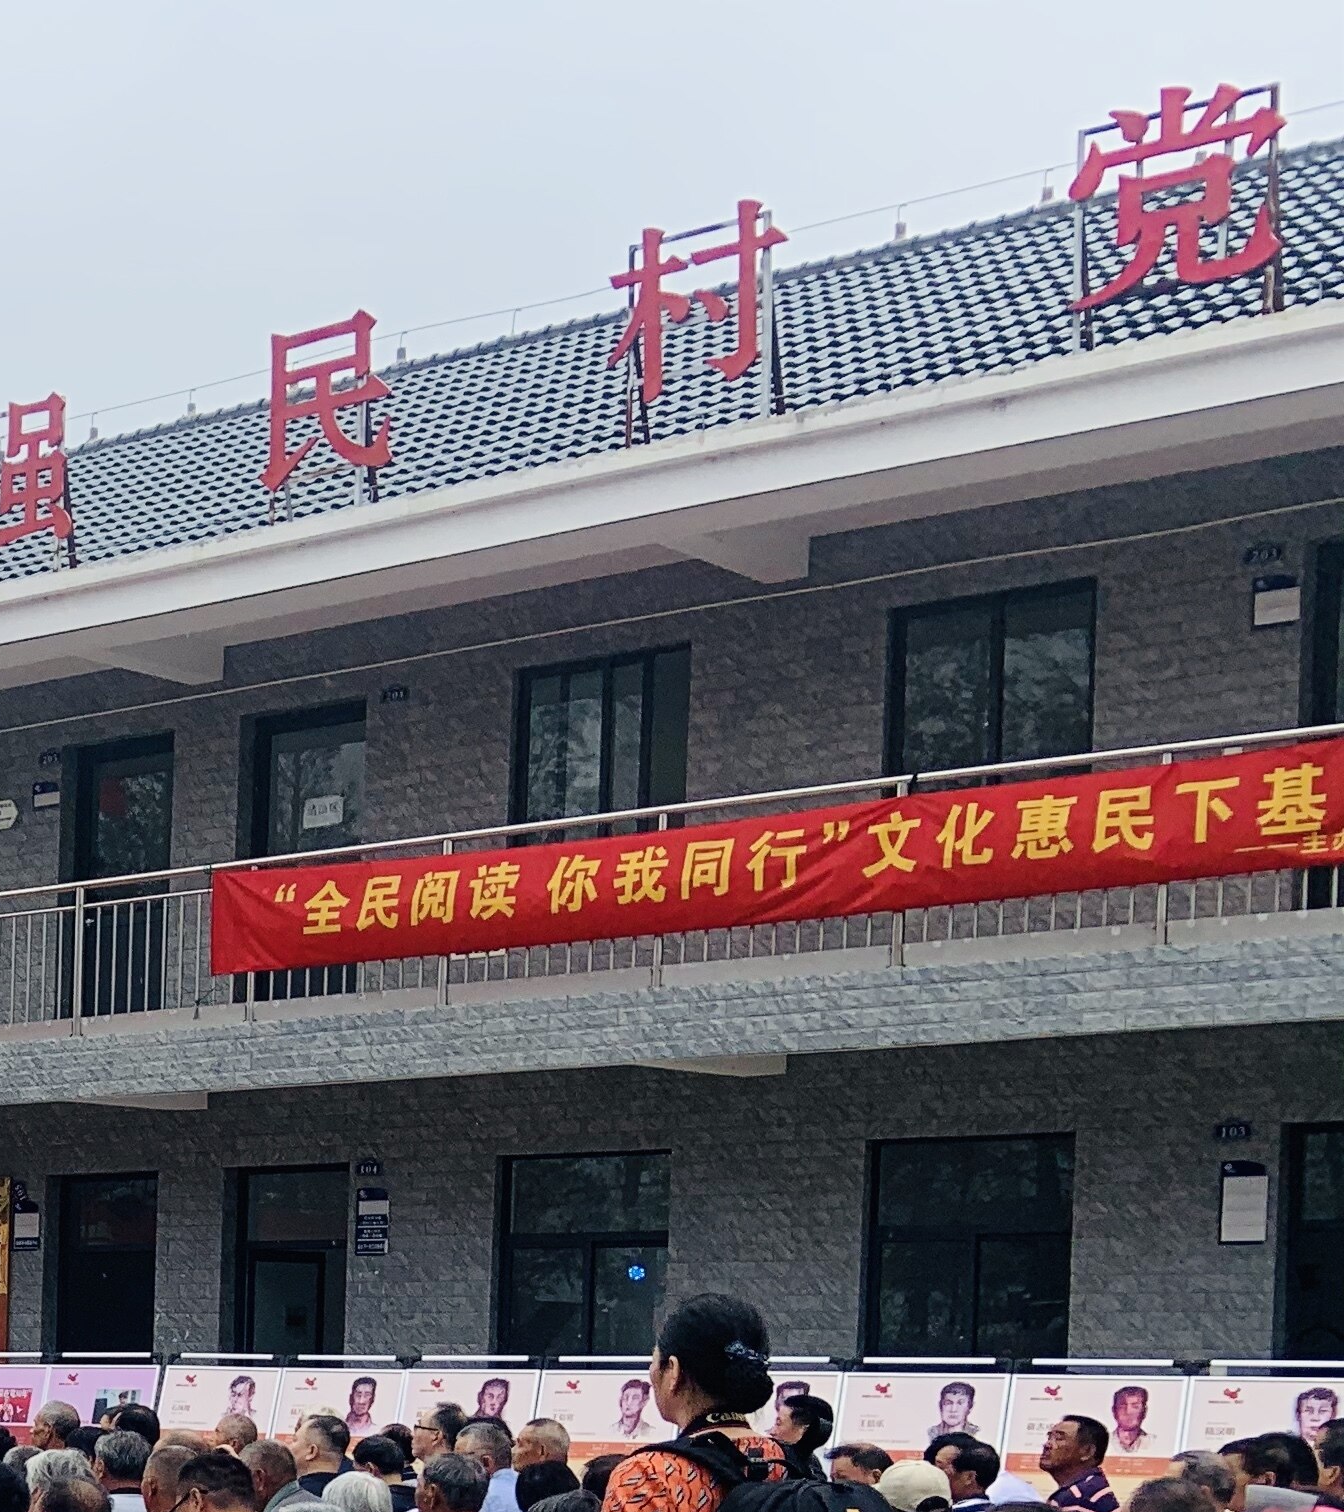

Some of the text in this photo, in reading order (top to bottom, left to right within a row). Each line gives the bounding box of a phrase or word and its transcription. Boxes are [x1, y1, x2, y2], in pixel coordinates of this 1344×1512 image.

[273, 862, 520, 936] “全民阅读
[1220, 1126, 1247, 1138] 103
